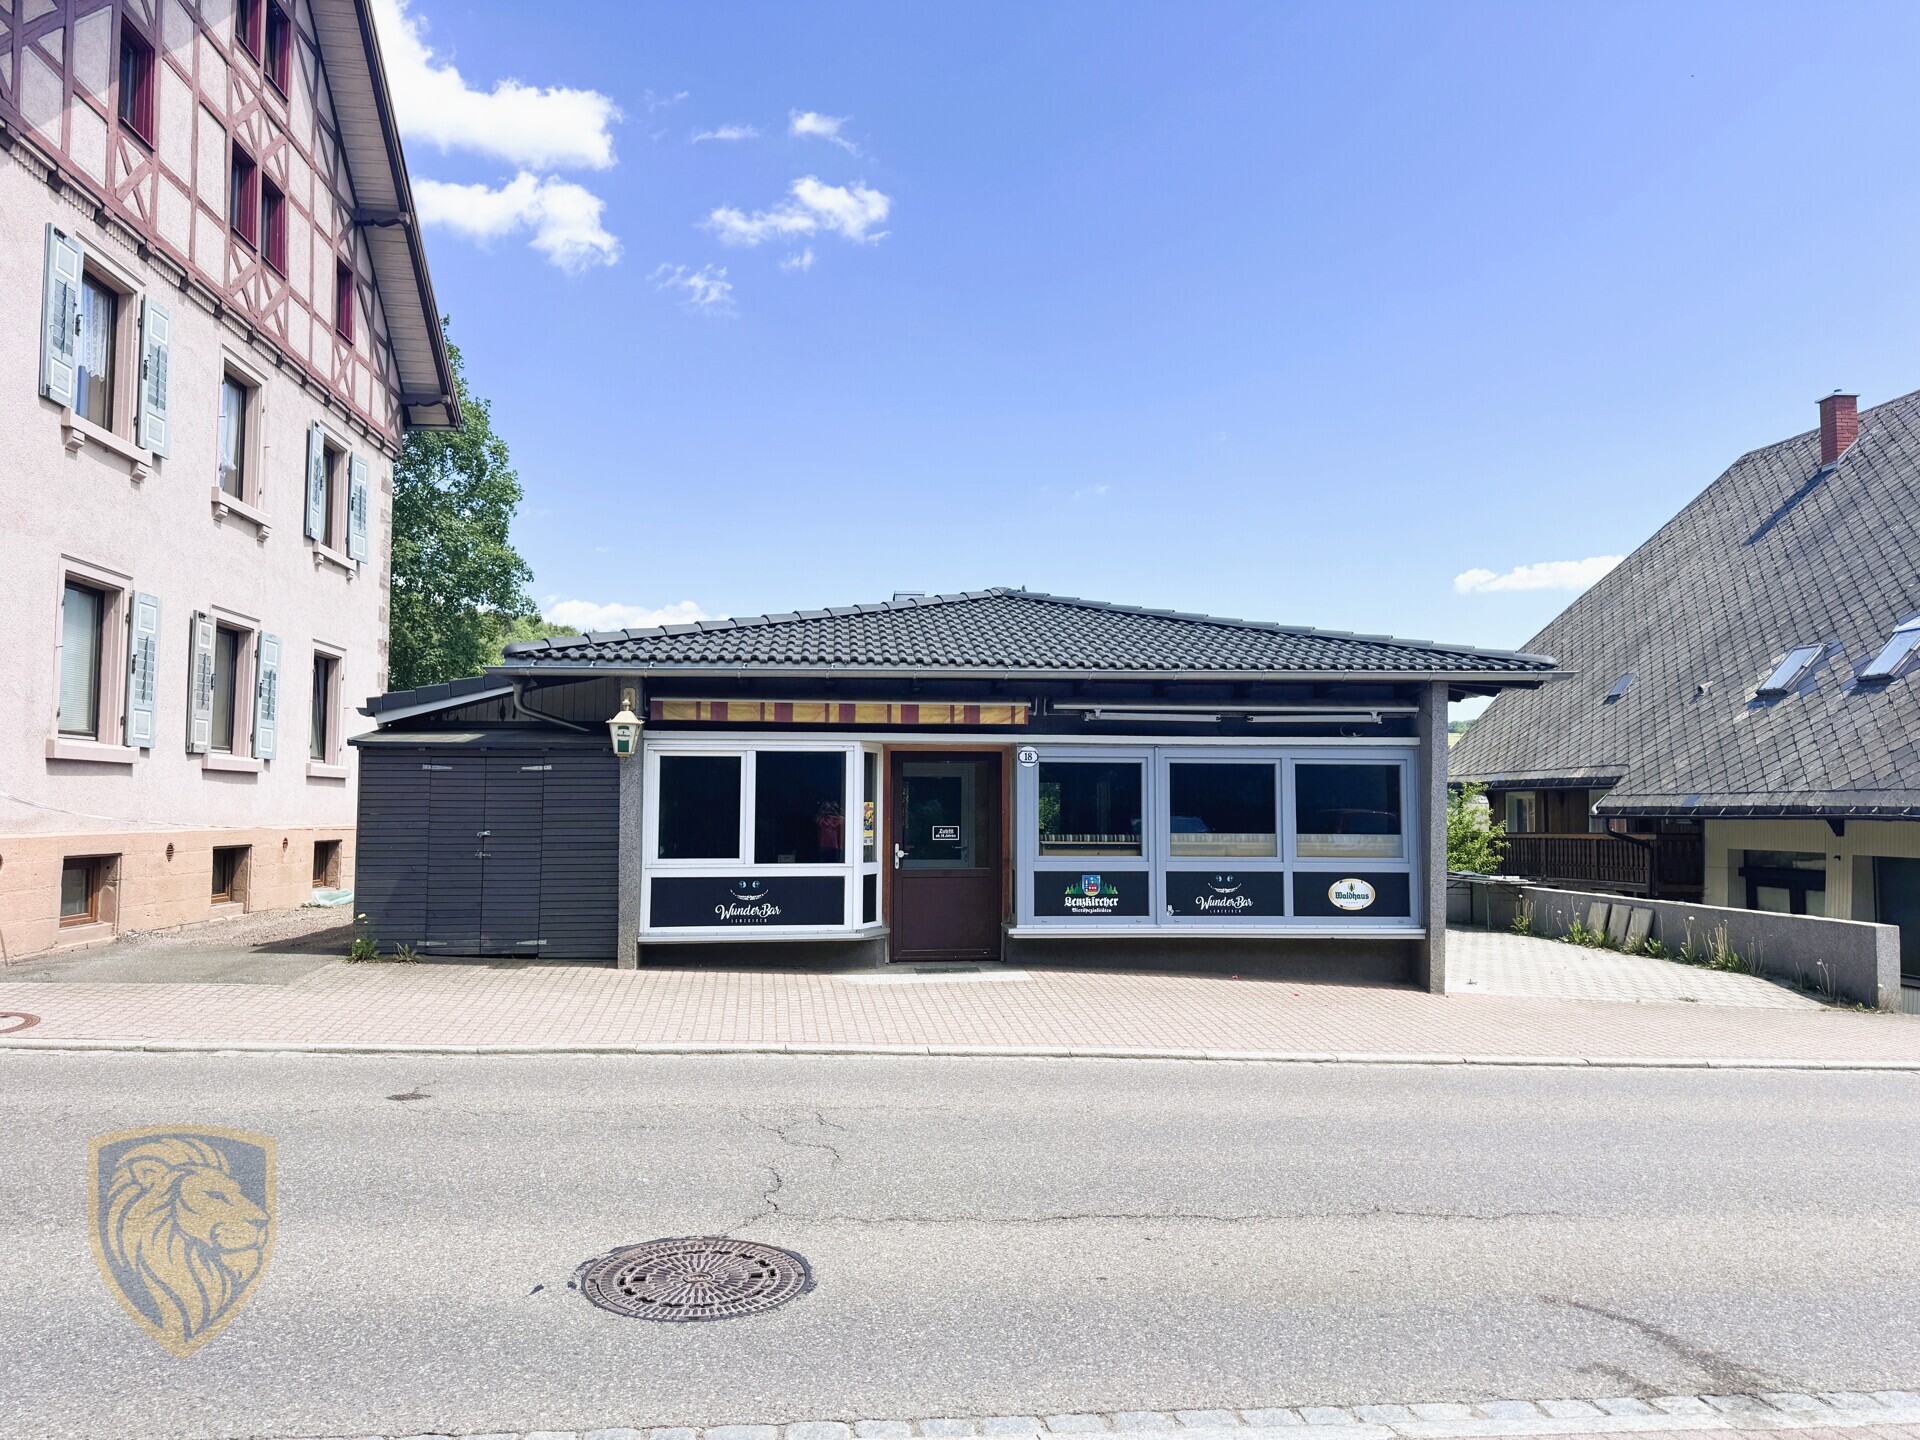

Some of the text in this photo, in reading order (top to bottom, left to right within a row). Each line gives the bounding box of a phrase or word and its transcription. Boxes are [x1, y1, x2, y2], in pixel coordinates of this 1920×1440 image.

[1024, 752, 1033, 761] 18
[1064, 896, 1119, 907] Lenzkircher
[1335, 891, 1370, 901] Waldhaus
[1195, 895, 1254, 910] WunderBar
[715, 903, 781, 920] WunderBar
